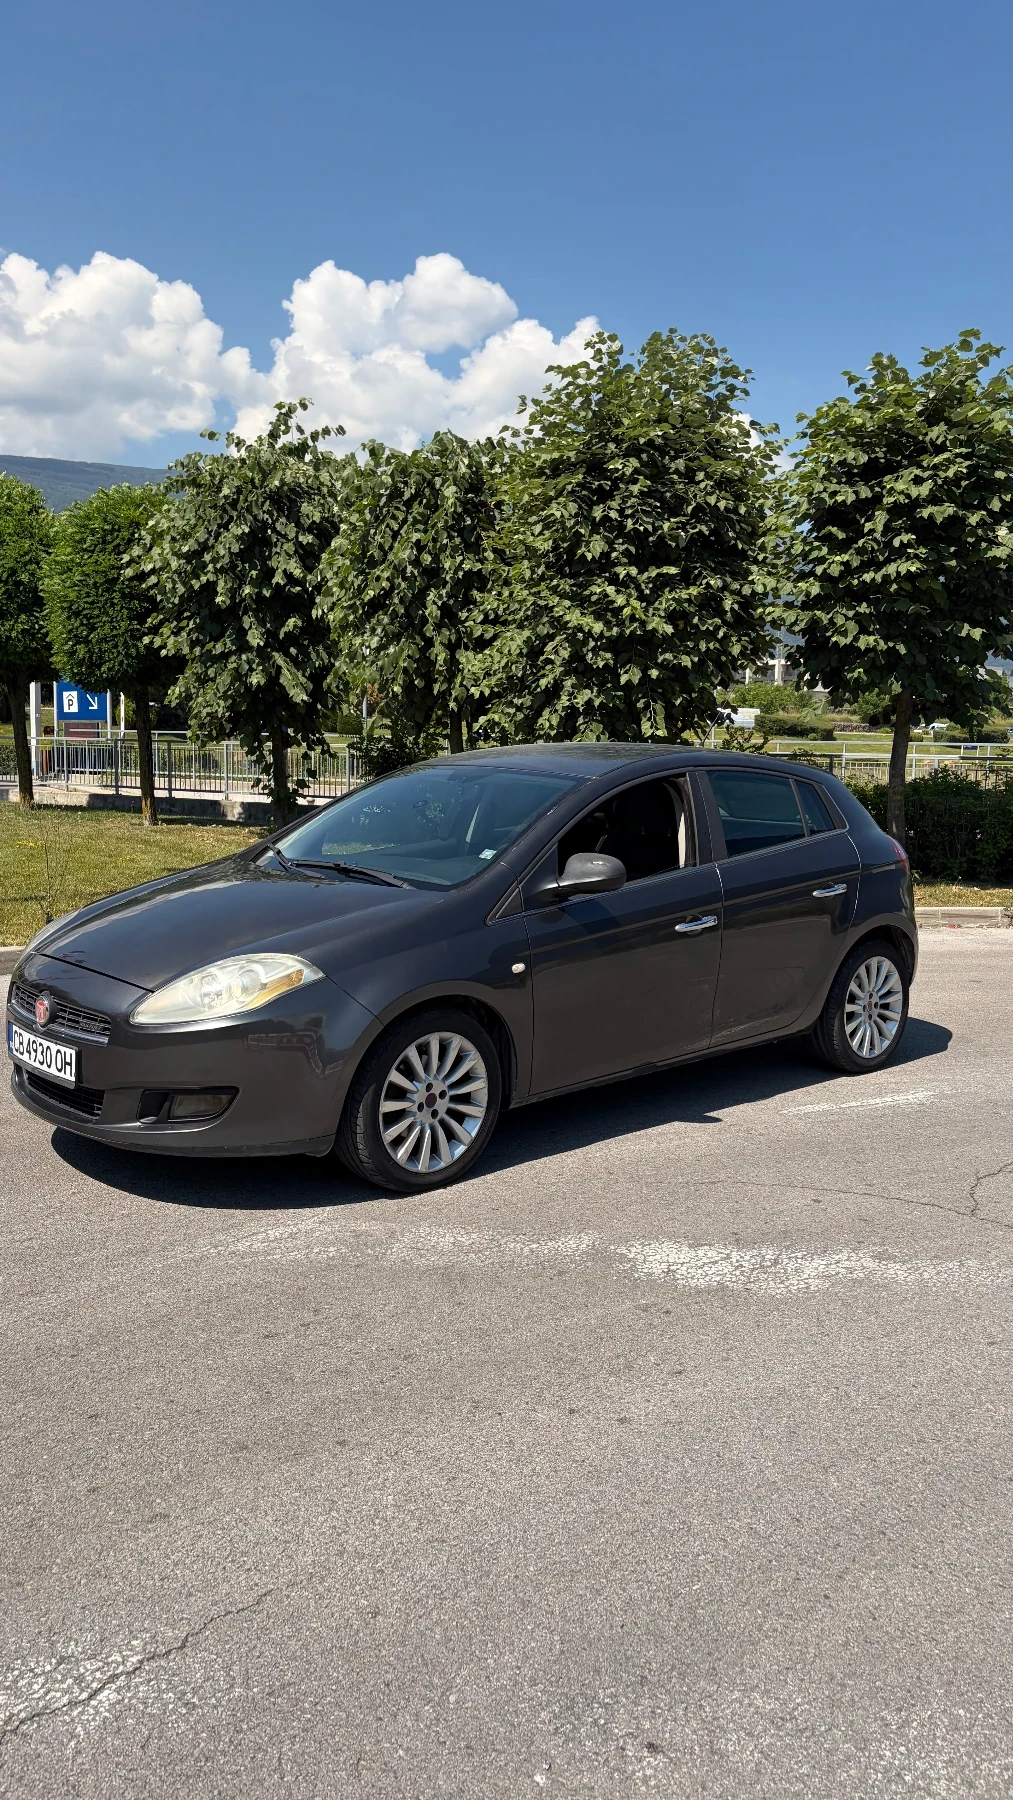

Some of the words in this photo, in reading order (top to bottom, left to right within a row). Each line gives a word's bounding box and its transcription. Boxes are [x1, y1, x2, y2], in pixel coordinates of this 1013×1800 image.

[67, 699, 74, 710] P
[13, 1030, 24, 1056] CB
[26, 1037, 52, 1069] 4930
[55, 1049, 73, 1077] OH
